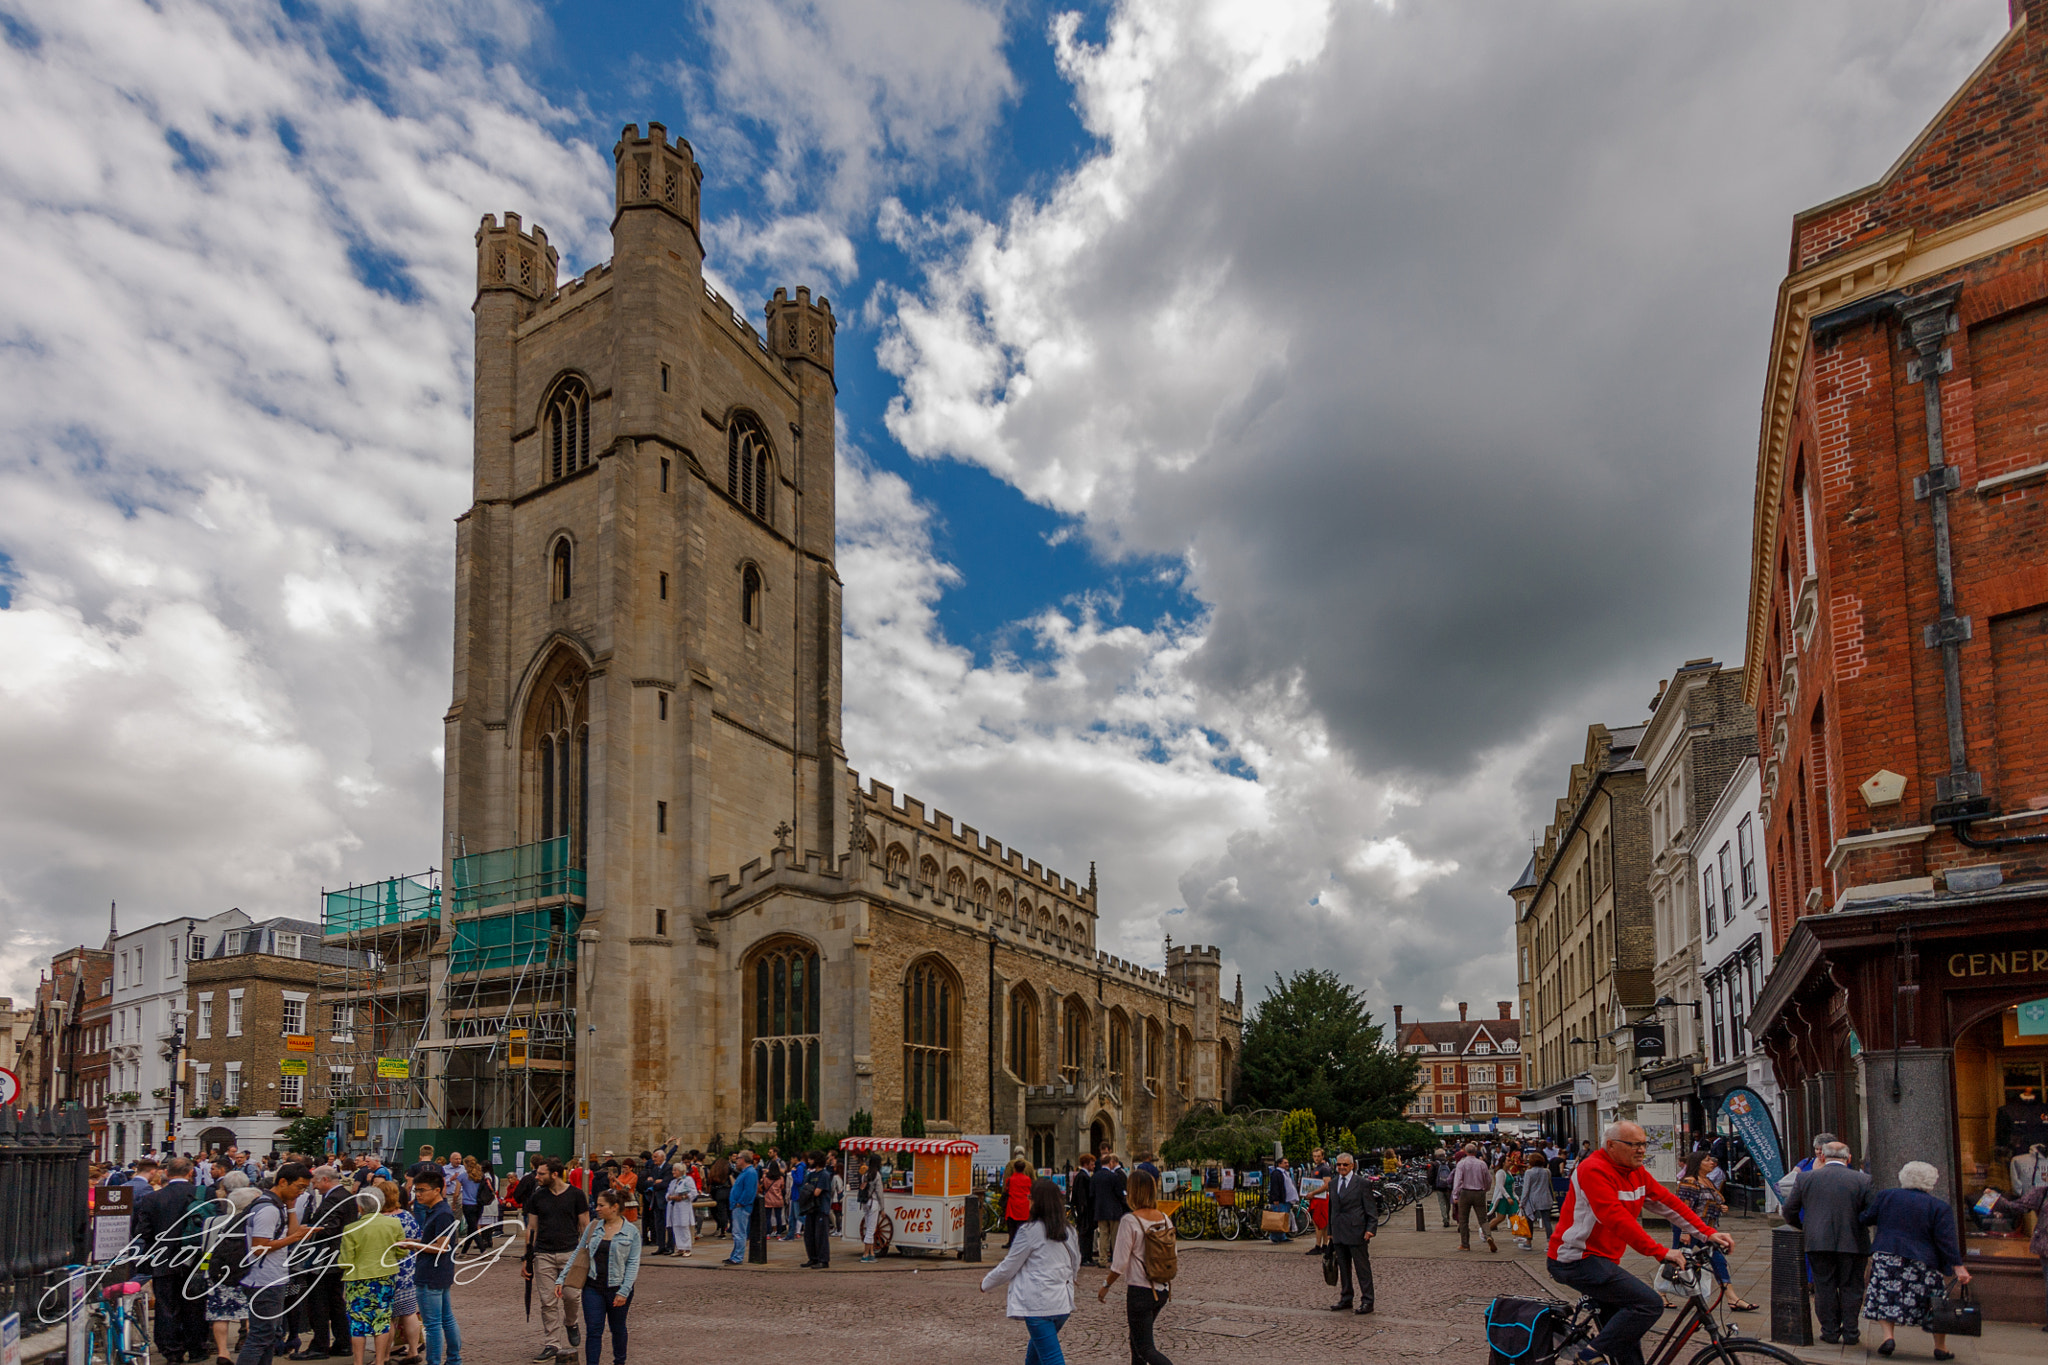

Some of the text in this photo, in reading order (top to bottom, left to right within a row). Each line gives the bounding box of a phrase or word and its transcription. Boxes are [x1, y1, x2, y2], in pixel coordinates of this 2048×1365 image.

[1948, 950, 2048, 977] GENER
[894, 1206, 933, 1220] TONI'S
[904, 1220, 933, 1233] ICES
[952, 1217, 965, 1232] ICE
